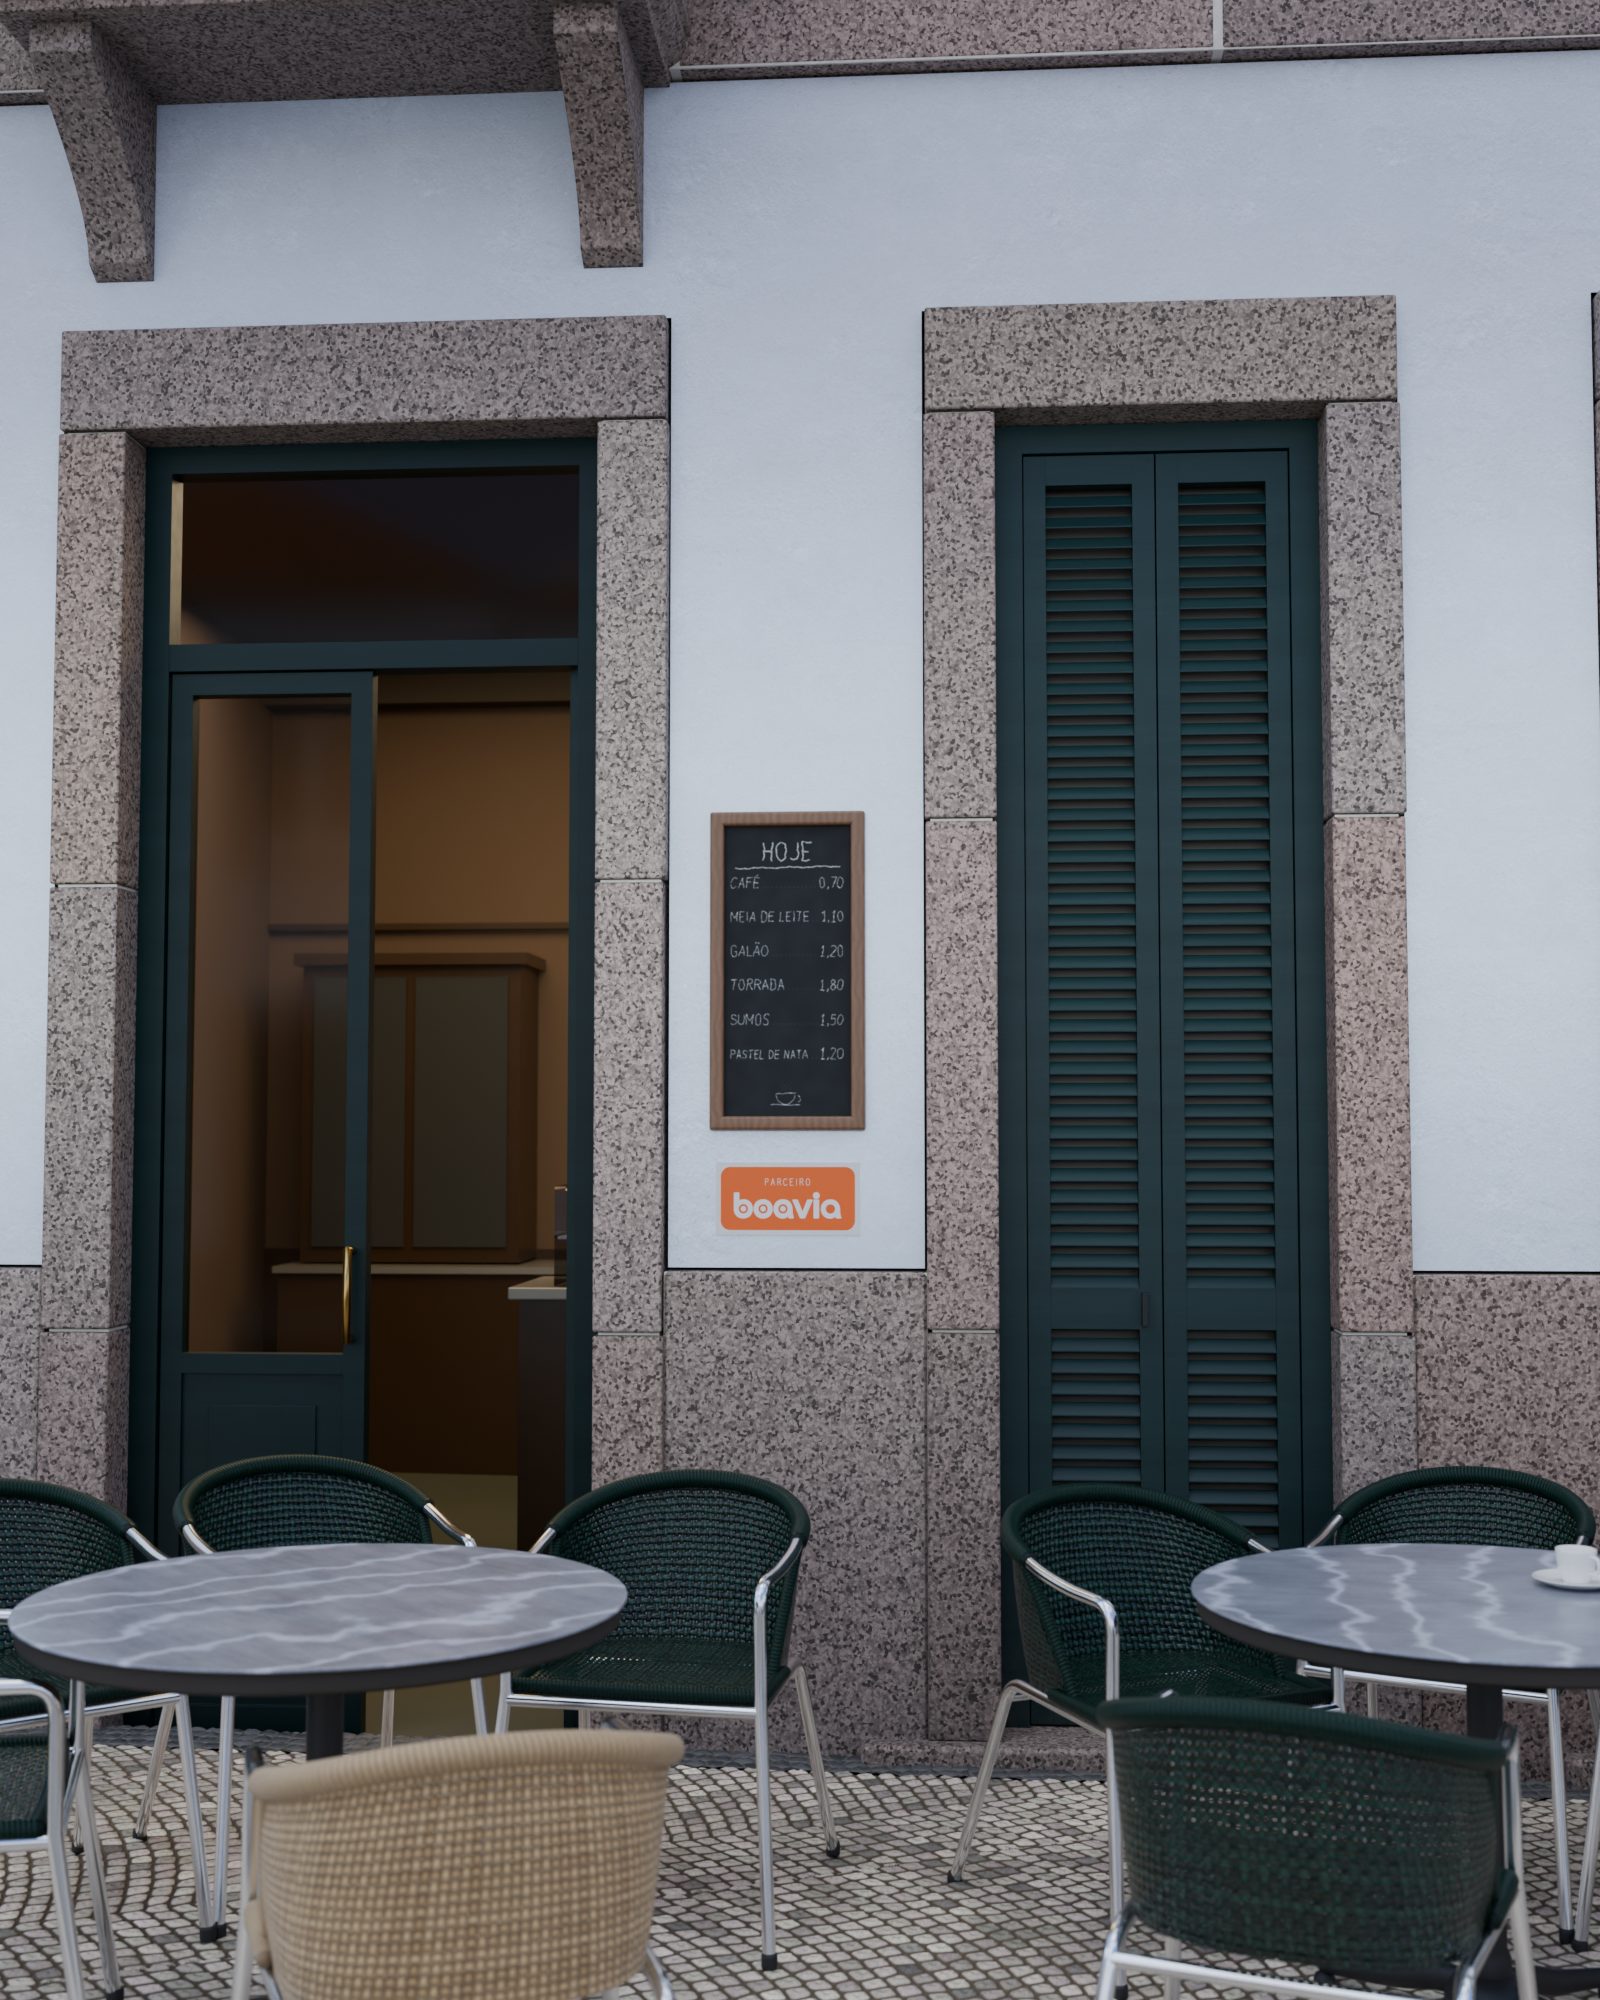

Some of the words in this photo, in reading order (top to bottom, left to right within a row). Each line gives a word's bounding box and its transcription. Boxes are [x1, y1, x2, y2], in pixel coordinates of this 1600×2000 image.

[762, 840, 812, 862] HOJE
[730, 874, 760, 890] CAFÉ
[819, 876, 844, 890] 0,70
[730, 910, 756, 923] MEIA
[760, 910, 775, 923] DE
[778, 910, 810, 923] LEITE
[821, 910, 844, 923] 1,10
[730, 941, 769, 958] GALÃO
[820, 944, 844, 959] 1,20
[730, 978, 785, 991] TORRADA
[819, 978, 845, 993] 1,80
[730, 1013, 770, 1026] SUMOS
[820, 1013, 845, 1027] 1,50
[729, 1049, 764, 1060] PASTEL
[768, 1049, 780, 1060] DE
[783, 1049, 809, 1059] NATA
[820, 1047, 845, 1061] 1,20
[764, 1177, 811, 1187] PARCEIRO
[733, 1191, 842, 1219] boavia
